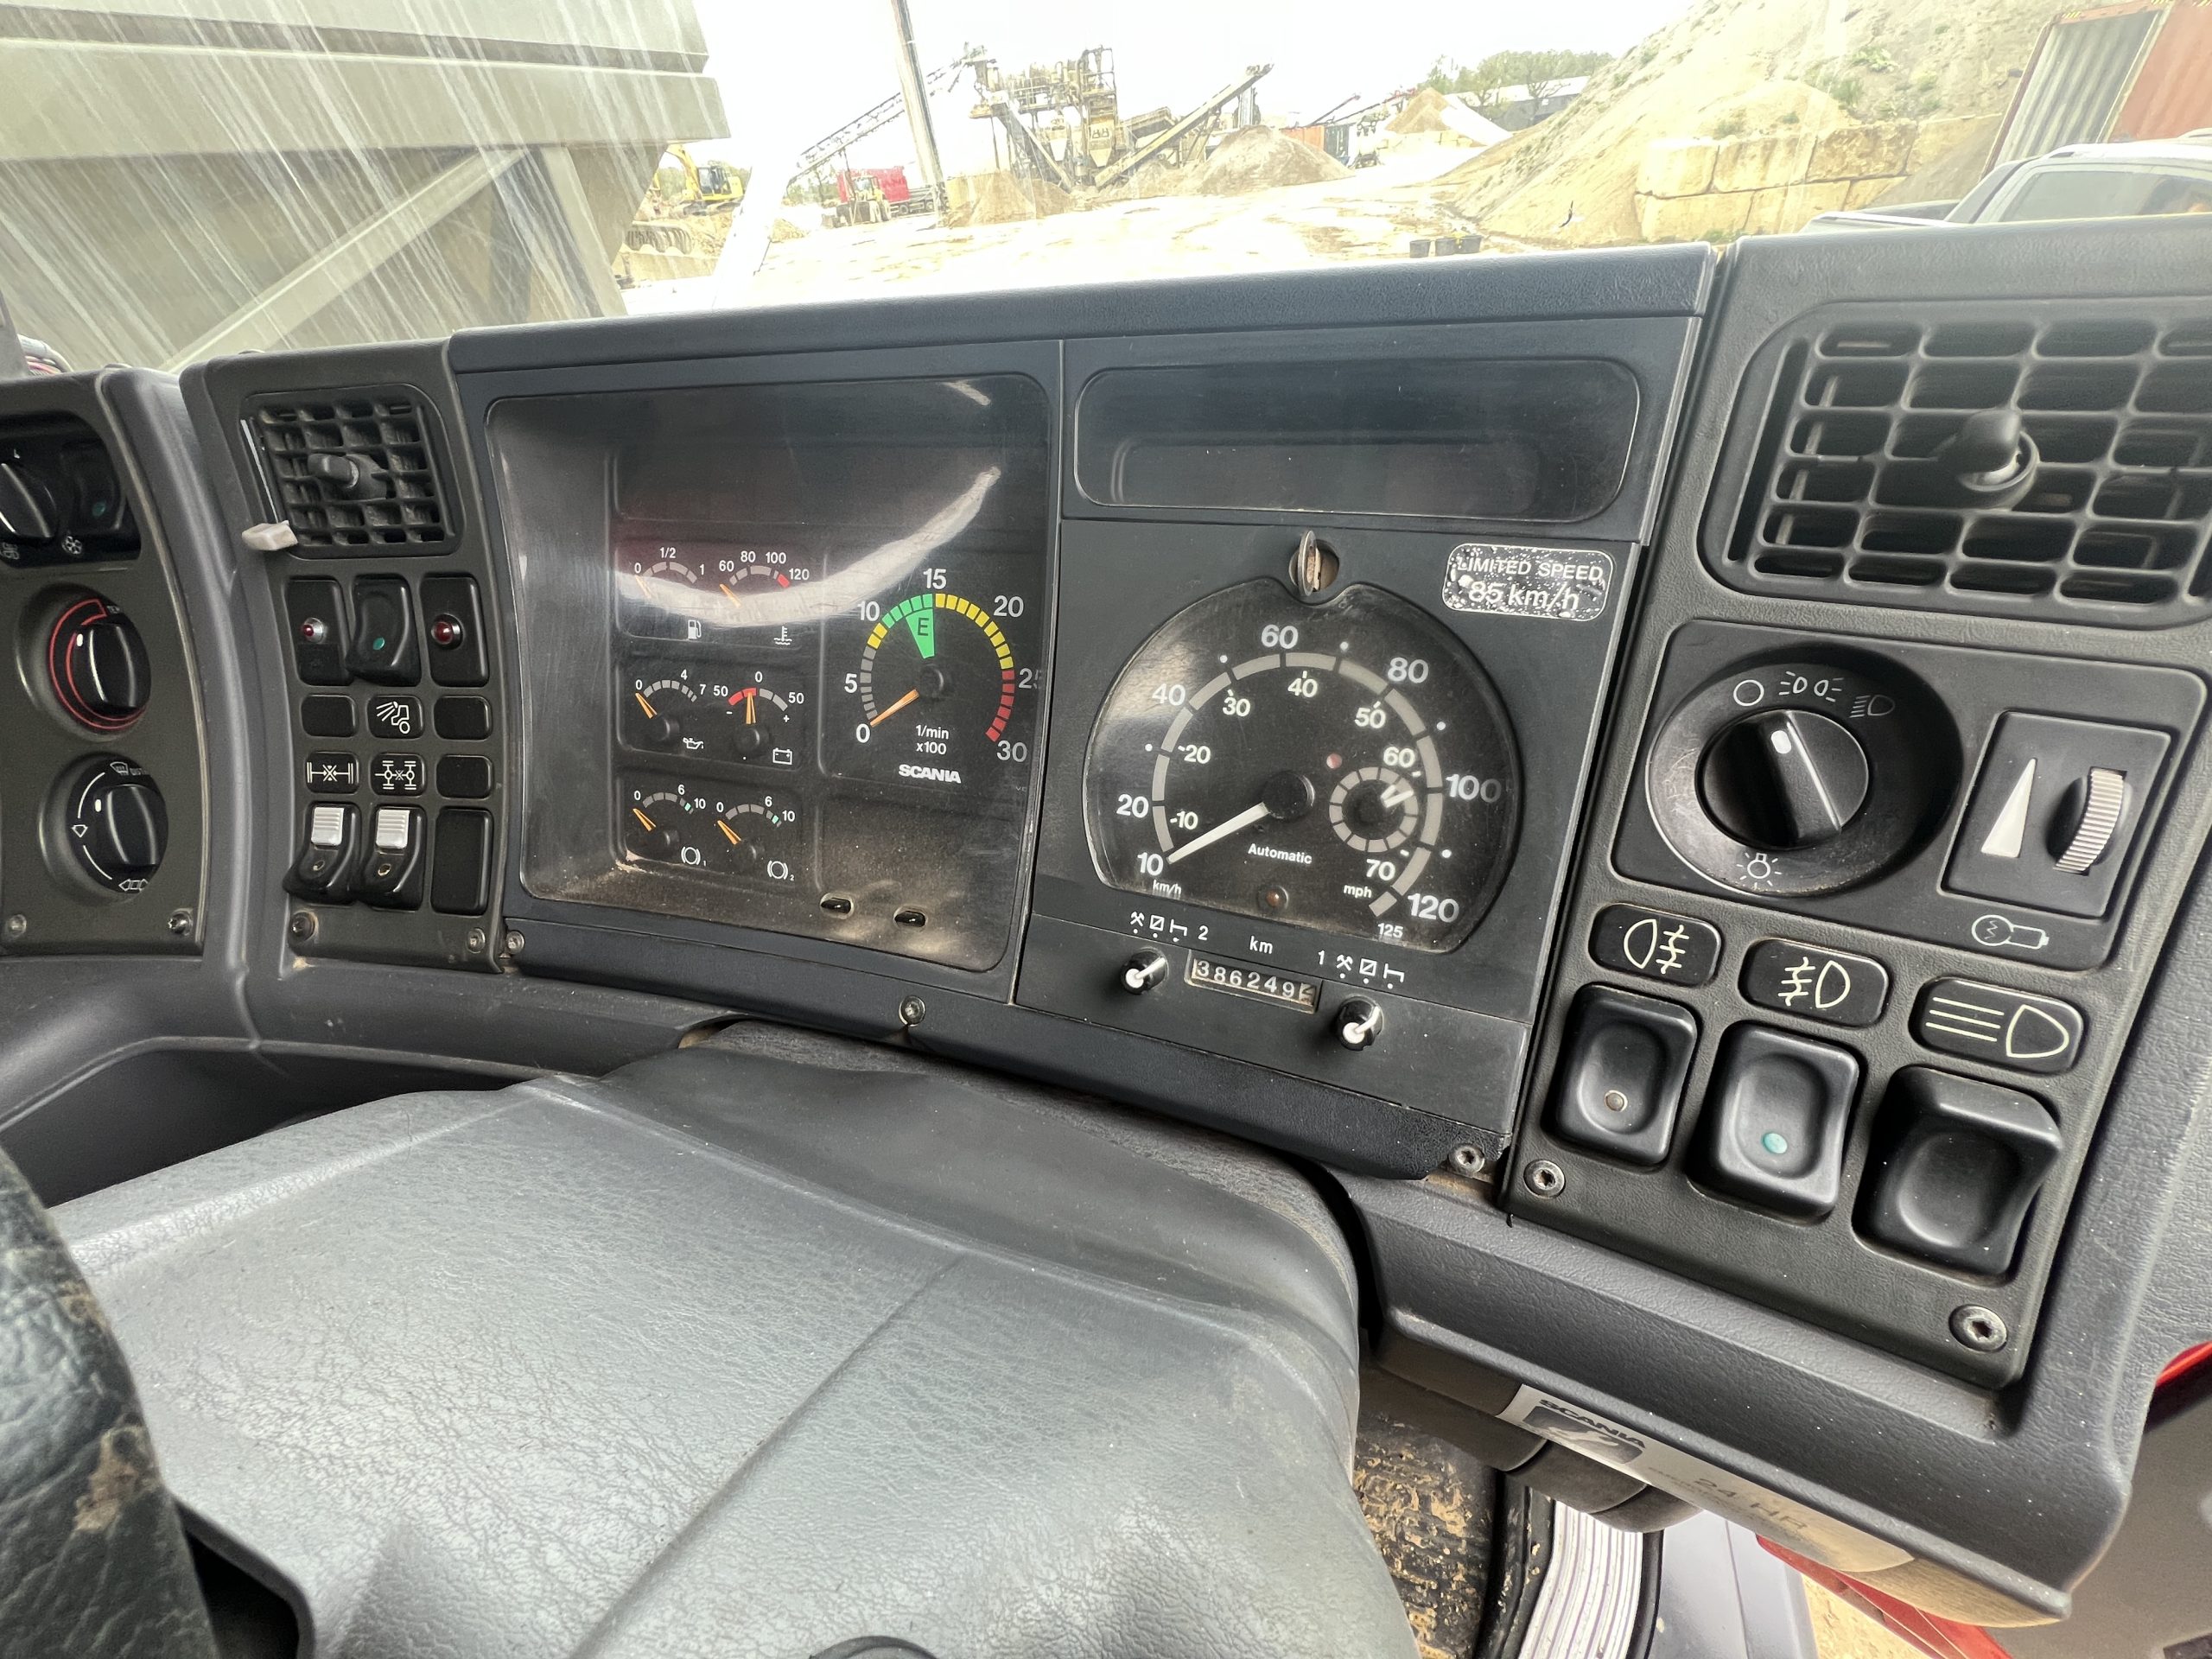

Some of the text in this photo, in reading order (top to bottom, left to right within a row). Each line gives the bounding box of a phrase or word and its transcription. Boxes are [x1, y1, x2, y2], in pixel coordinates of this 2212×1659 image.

[659, 547, 677, 559] 1/2
[741, 550, 756, 563] 80
[766, 551, 786, 565] 100
[634, 563, 641, 574] 0
[700, 564, 705, 575] 1
[719, 560, 734, 572] 60
[1457, 556, 1604, 582] LIMITED SPEED
[789, 569, 810, 581] 120
[923, 568, 947, 589] 15
[1469, 581, 1580, 611] 85 km/h
[857, 601, 880, 622] 10
[994, 594, 1024, 618] 20
[918, 617, 930, 636] E
[1262, 624, 1299, 649] 60
[681, 669, 688, 680] 4
[754, 671, 763, 683] 0
[1387, 657, 1429, 683] 80
[635, 679, 643, 690] 0
[699, 683, 707, 695] 7
[713, 685, 728, 697] 50
[844, 673, 858, 693] 5
[1287, 677, 1319, 698] 40
[788, 692, 804, 704] 50
[1152, 683, 1186, 706] 40
[1222, 696, 1251, 717] 30
[1354, 707, 1386, 729] 50
[855, 723, 871, 743] 0
[915, 724, 950, 740] 1/min
[916, 741, 947, 755] x100
[996, 740, 1027, 762] 30
[1382, 747, 1415, 768] 60
[899, 764, 962, 784] SCANIA
[633, 790, 641, 801] 0
[677, 785, 685, 795] 6
[1446, 773, 1502, 803] 100
[694, 798, 706, 809] 10
[715, 802, 724, 813] 0
[765, 795, 772, 807] 6
[1116, 793, 1149, 818] 20
[782, 810, 795, 823] 10
[1248, 842, 1313, 865] Automatic
[1137, 852, 1164, 876] 10
[1365, 858, 1396, 881] 70
[1153, 879, 1182, 895] km/h
[1343, 884, 1372, 899] mph
[1407, 893, 1459, 923] 120
[1198, 925, 1209, 941] 2
[1377, 923, 1404, 938] 125
[1249, 935, 1274, 955] km
[1318, 950, 1325, 965] 1
[1538, 1399, 1645, 1449] SCANIA
